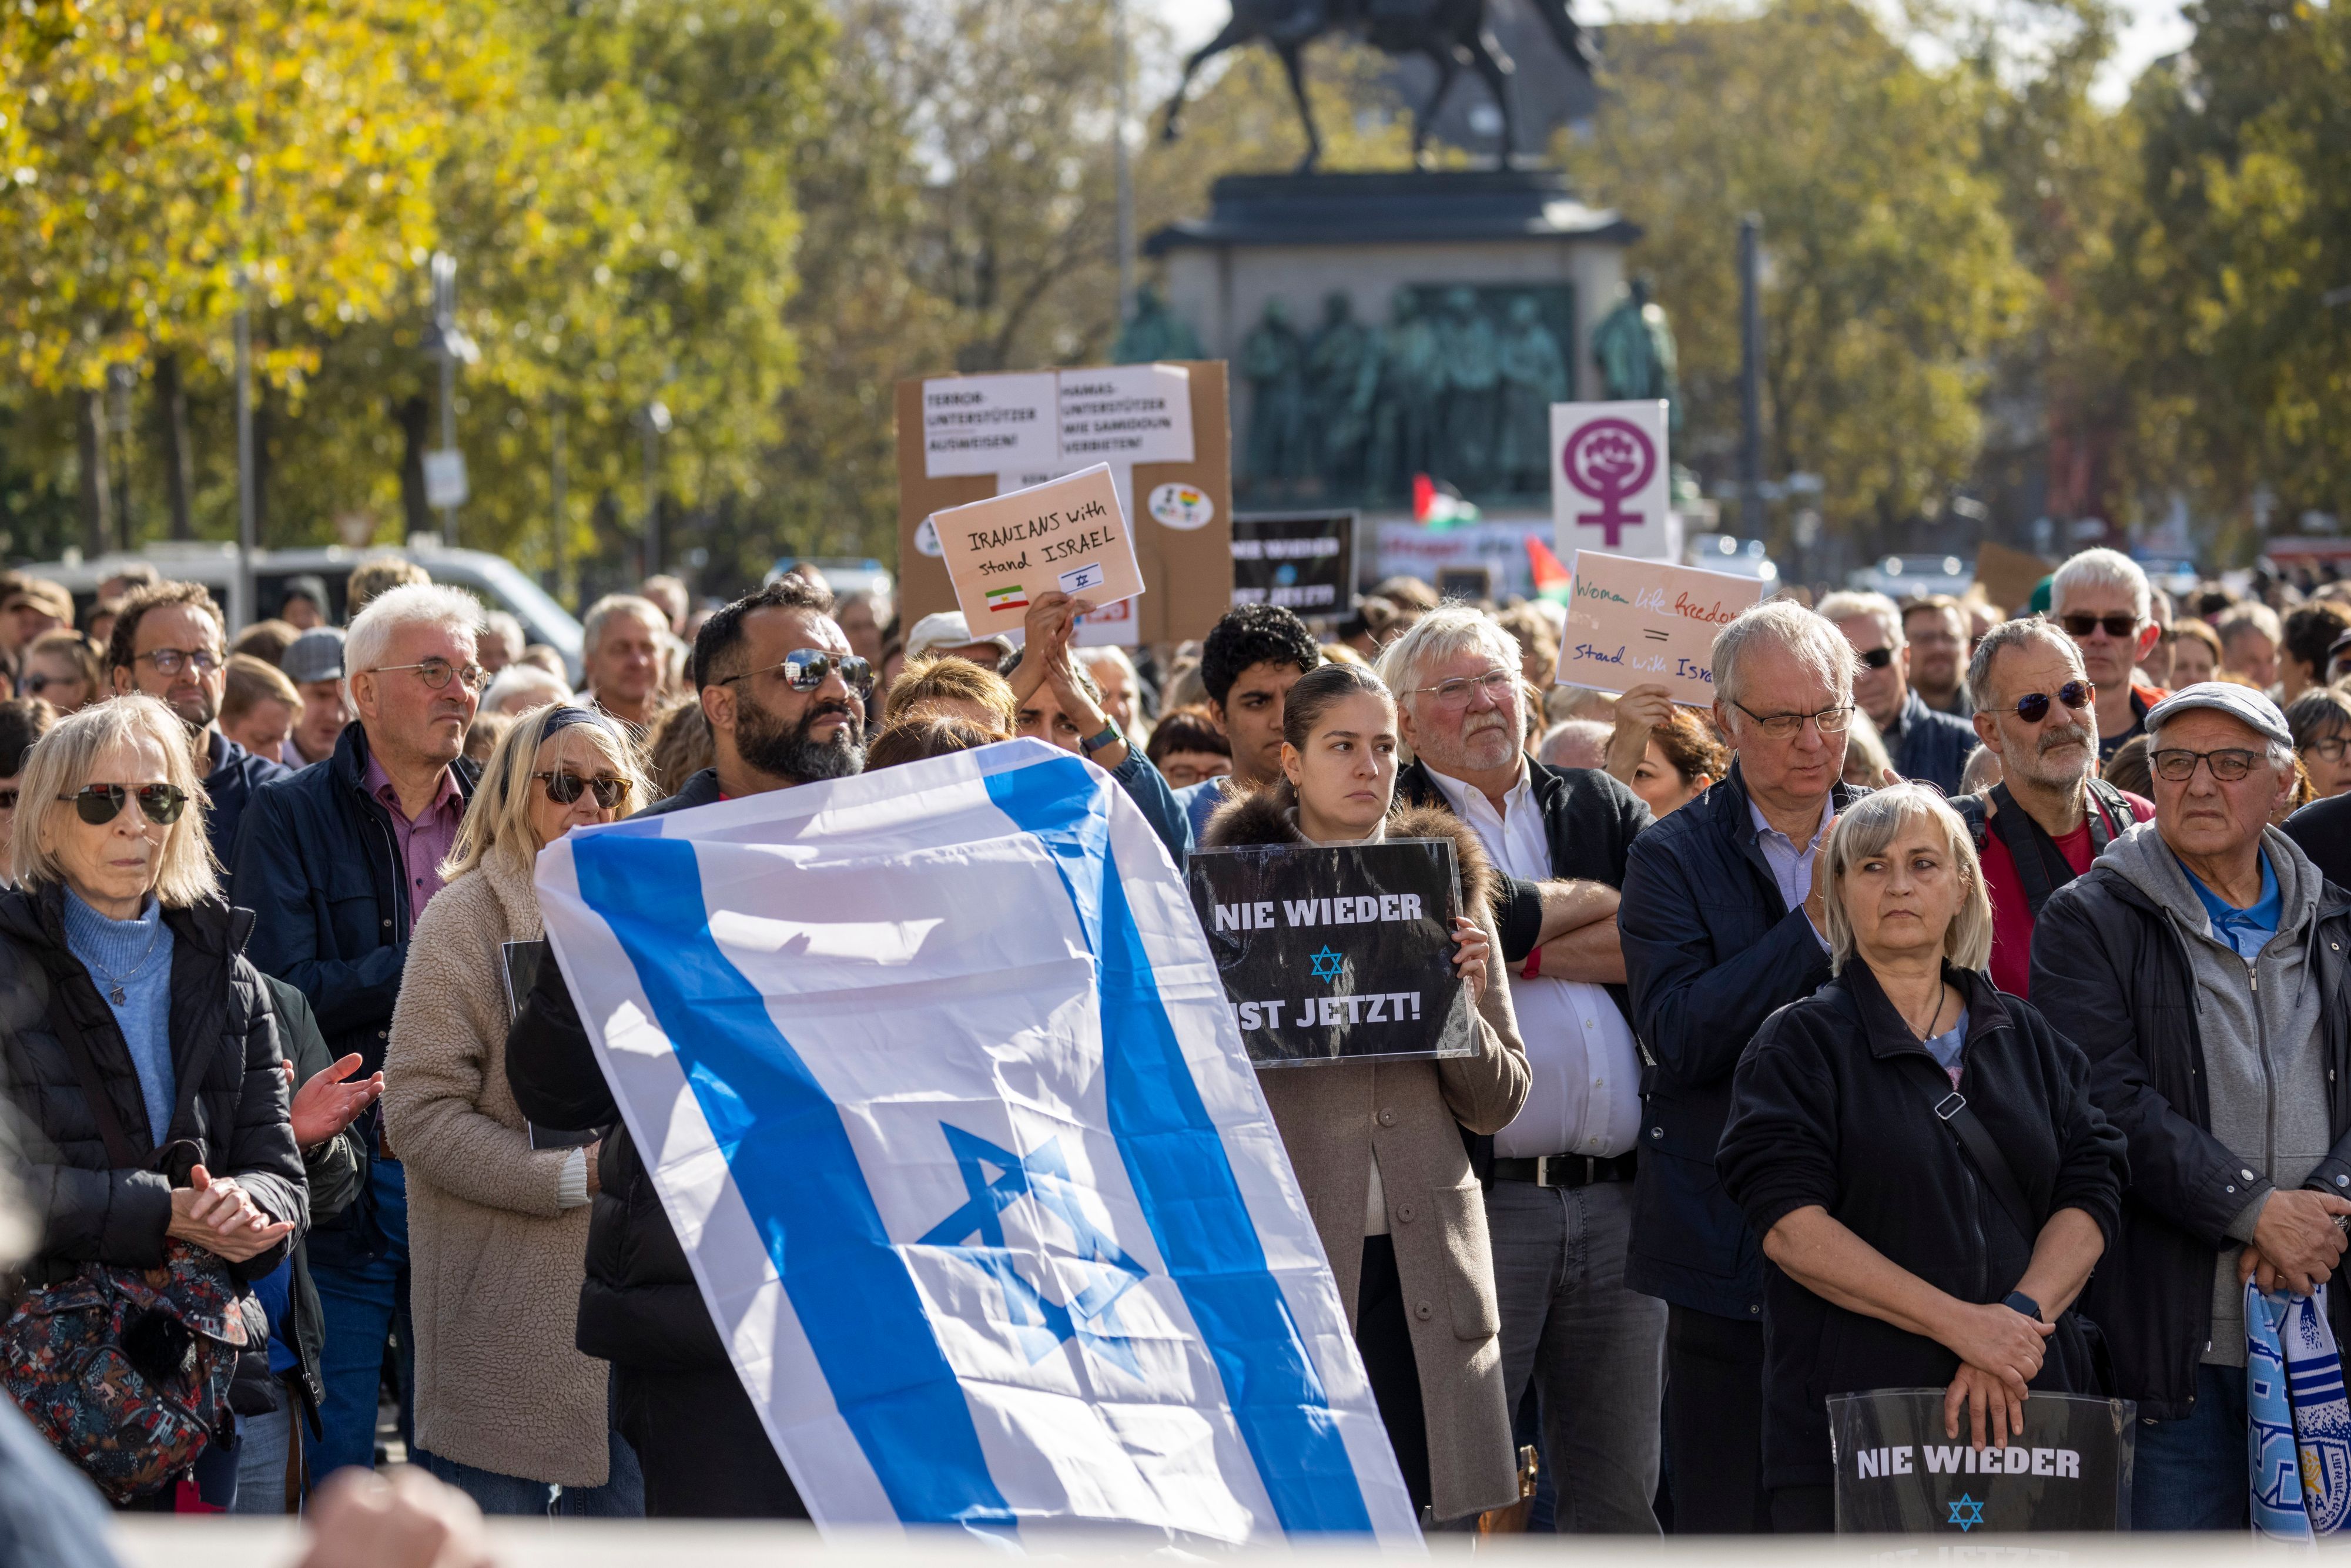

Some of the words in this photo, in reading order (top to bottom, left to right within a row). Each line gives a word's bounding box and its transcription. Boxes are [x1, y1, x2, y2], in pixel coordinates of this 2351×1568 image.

[927, 407, 1036, 425] UNTERSTÜTZER
[1061, 396, 1166, 417] UNTERSTÜTZER
[1064, 422, 1088, 433] WIE
[1094, 417, 1172, 432] SAMIDOUN
[929, 434, 1018, 451] AUSWEISEN!
[1063, 435, 1143, 454] VERBIETEN!
[968, 512, 1060, 551] IRANIANS
[1066, 500, 1107, 523] with
[1041, 525, 1115, 562] ISRAEL
[1576, 575, 1629, 604] Woman
[1215, 902, 1274, 932] NIE
[1283, 893, 1422, 927] WIEDER
[1296, 991, 1420, 1027] JETZT!
[1857, 1446, 1913, 1479] NIE
[1923, 1445, 2080, 1479] WIEDER
